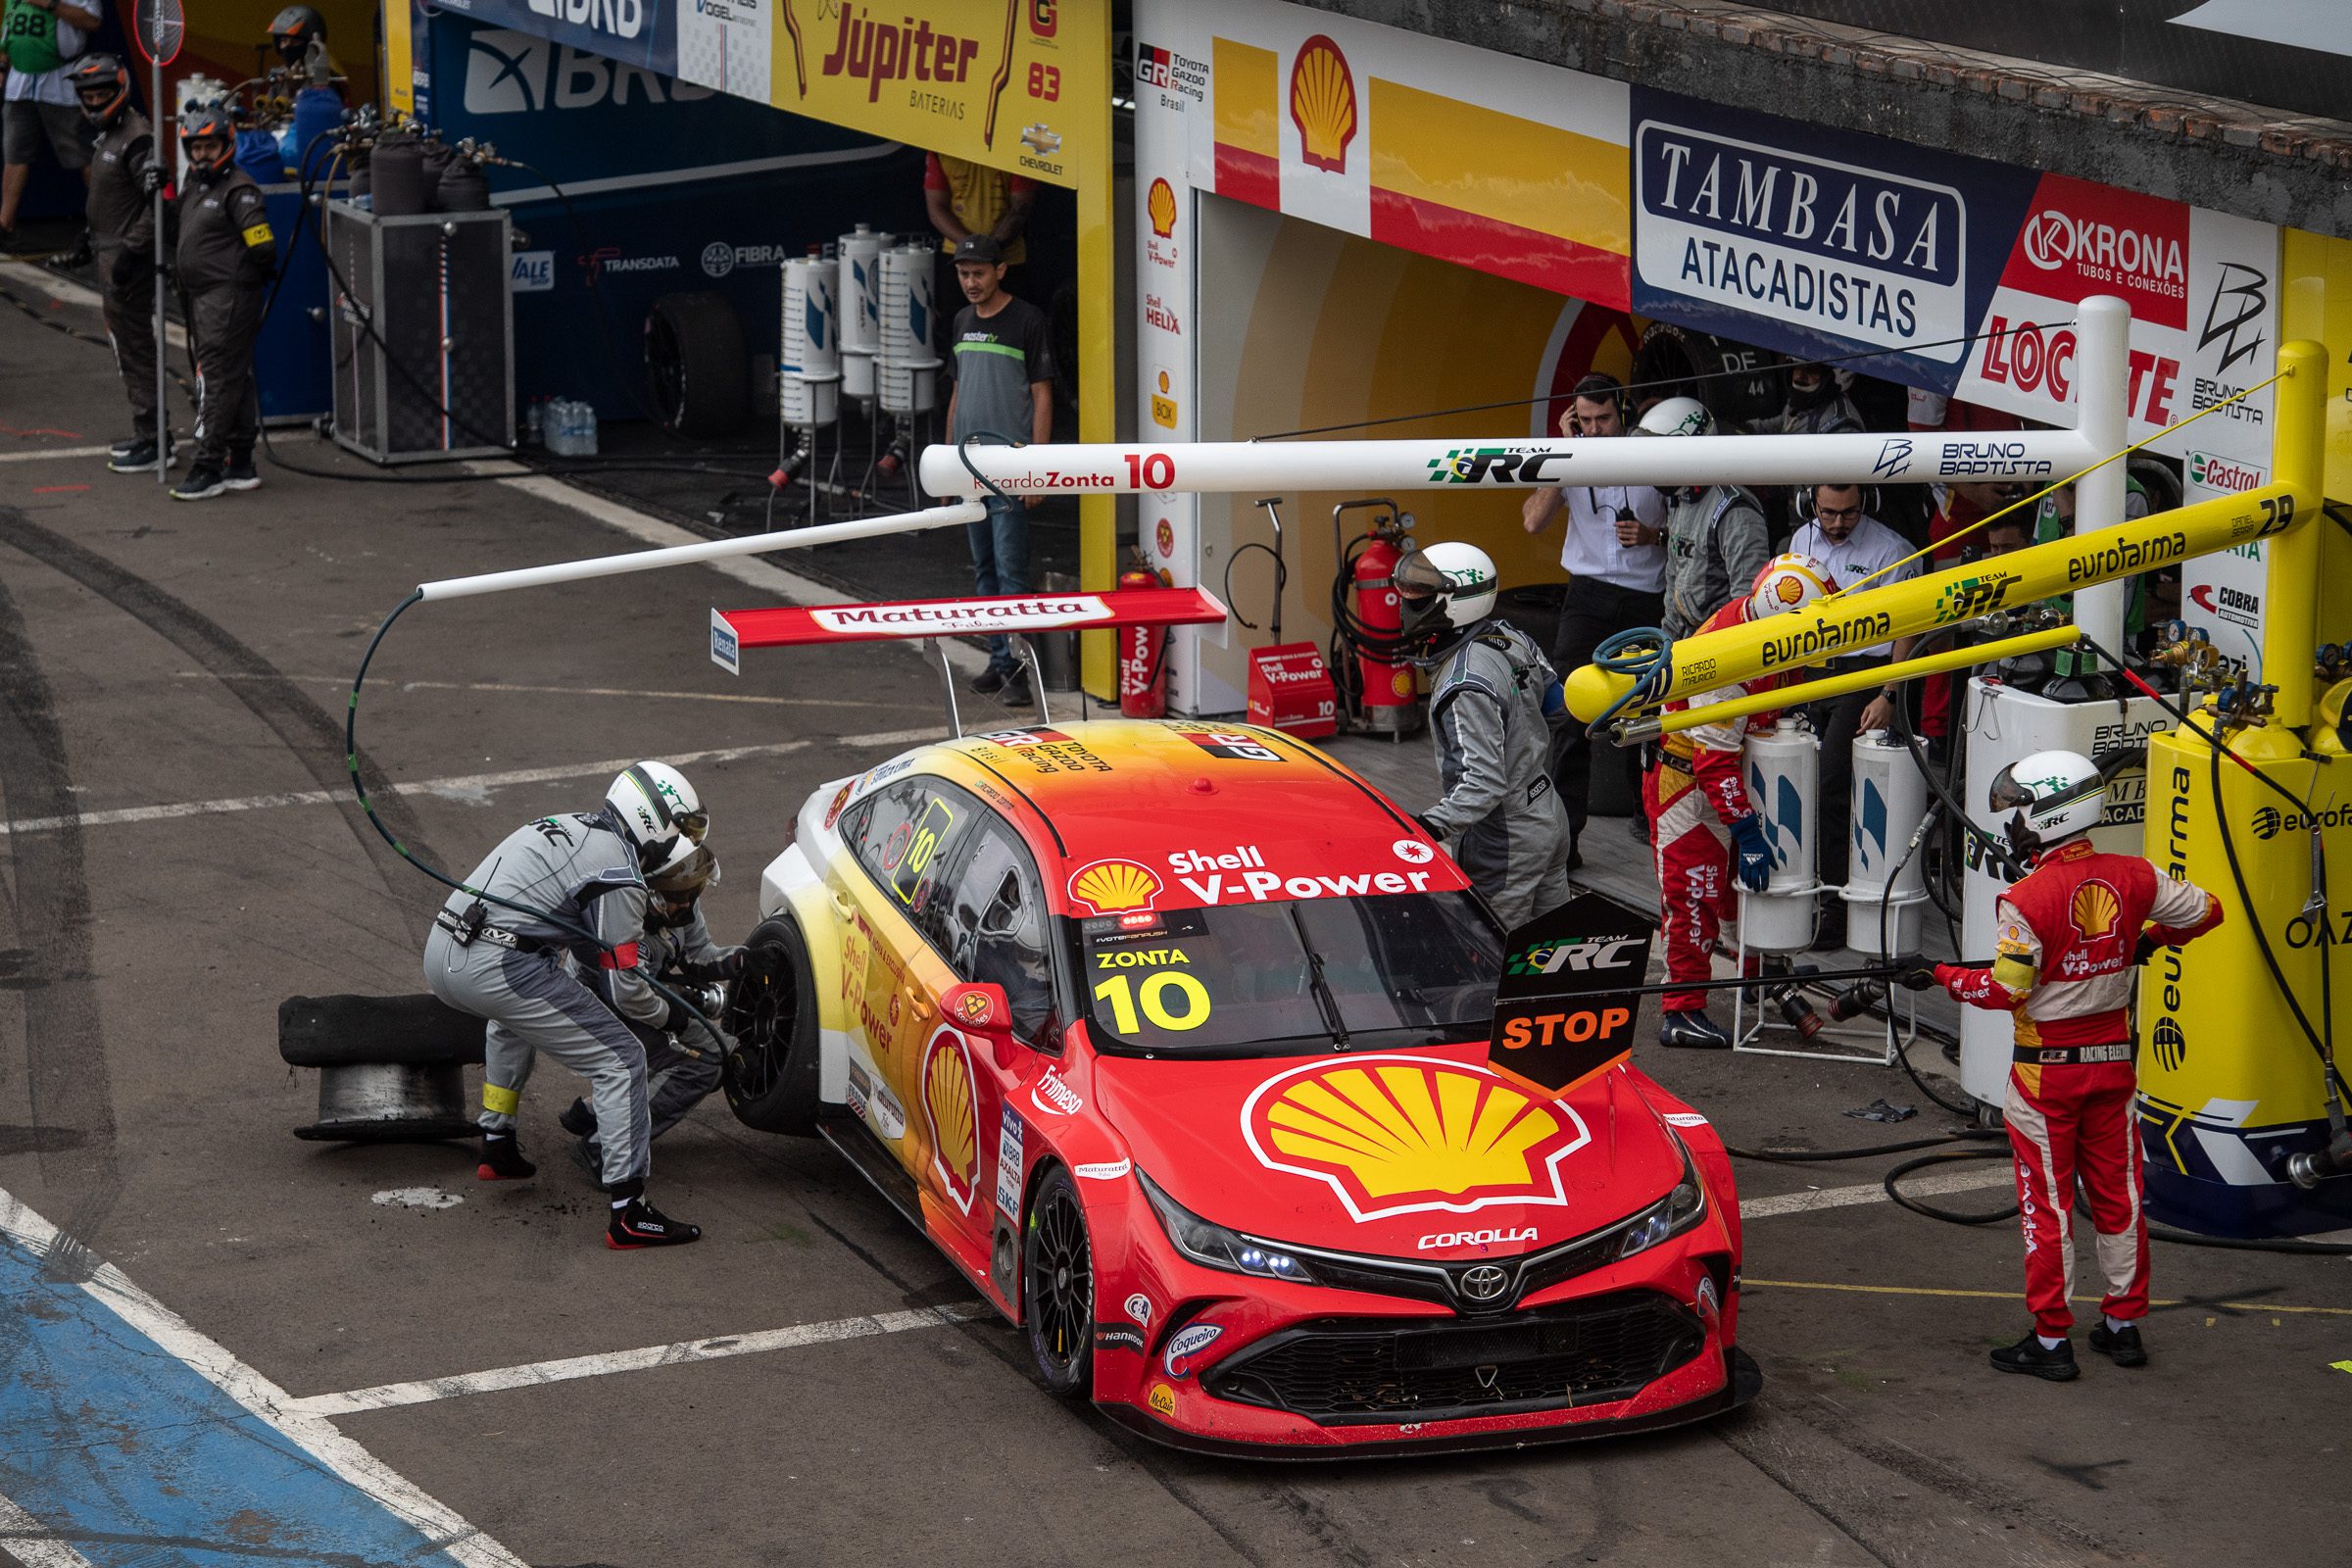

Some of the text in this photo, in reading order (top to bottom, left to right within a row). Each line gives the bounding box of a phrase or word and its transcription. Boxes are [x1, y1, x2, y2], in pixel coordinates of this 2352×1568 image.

[13, 13, 46, 36] 88
[822, 2, 978, 103] Júpiter
[1173, 54, 1209, 74] TOYOTA
[1028, 62, 1060, 102] 83
[1137, 60, 1168, 87] GR
[1172, 67, 1205, 86] GAZOO
[1160, 95, 1186, 113] Brasil
[1171, 79, 1203, 102] Racing
[909, 89, 965, 121] BATERIAS
[1019, 155, 1063, 176] CHEVROLET
[1661, 142, 1939, 272] TAMBASA
[606, 256, 680, 272] TRANSDATA
[734, 245, 785, 264] FIBRA
[1147, 250, 1176, 269] V-Power
[2077, 219, 2184, 284] KRONA
[1681, 236, 1917, 339] ATACADISTAS
[2077, 263, 2184, 300] TUBOS E CONEXÕES
[1146, 293, 1161, 309] Shell
[1146, 308, 1181, 335] HELIX
[1981, 315, 2180, 427] LOCTE
[2195, 378, 2247, 403] BRUNO
[1156, 401, 1172, 422] BOX
[2192, 394, 2263, 424] BAPTISTA
[1942, 443, 2025, 459] BRUNO
[1125, 453, 1176, 489] 10
[1466, 453, 1573, 483] RC
[1939, 461, 2052, 475] BAPTISTA
[2206, 459, 2260, 491] Castrol
[2230, 514, 2255, 528] DANIEL
[2256, 495, 2295, 536] 29
[2068, 532, 2186, 583] eurofarma
[1980, 570, 2008, 583] TEAM
[831, 601, 1089, 625] Maturatta
[2219, 586, 2259, 614] COBRA
[713, 629, 736, 660] Renata
[1762, 610, 1891, 666] eurofarma
[1130, 625, 1150, 697] V-Pow
[1682, 658, 1717, 677] RICARDO
[1264, 668, 1323, 684] V-Power
[1318, 700, 1335, 716] 10
[2095, 719, 2168, 741] BRUNO
[1011, 746, 1058, 774] Racing
[1036, 743, 1086, 771] GAZOO
[1061, 742, 1114, 772] TOYOTA
[907, 826, 936, 873] 10
[1167, 846, 1266, 874] Shell
[1179, 869, 1431, 906] V-Power
[1705, 864, 1719, 898] Shell
[1686, 864, 1706, 947] V-Power
[1587, 934, 1629, 944] TEAM
[843, 935, 868, 978] Shell
[1096, 948, 1191, 969] ZONTA
[1542, 938, 1646, 974] RC
[2061, 956, 2125, 976] V-Power
[2063, 949, 2088, 961] Shell
[841, 962, 893, 1055] V-Power
[1094, 970, 1211, 1036] 10
[957, 1011, 989, 1026] corações
[1502, 1007, 1630, 1050] STOP
[2079, 1046, 2108, 1063] RACING
[1002, 1109, 1017, 1137] vivo
[1007, 1142, 1020, 1168] BRB
[1078, 1163, 1128, 1173] Maturatta
[1000, 1158, 1021, 1186] AXALTA
[998, 1186, 1019, 1215] SKF
[1417, 1227, 1539, 1250] COROLLA
[1170, 1327, 1218, 1354] Coqueiro
[1151, 1392, 1174, 1412] McCain
